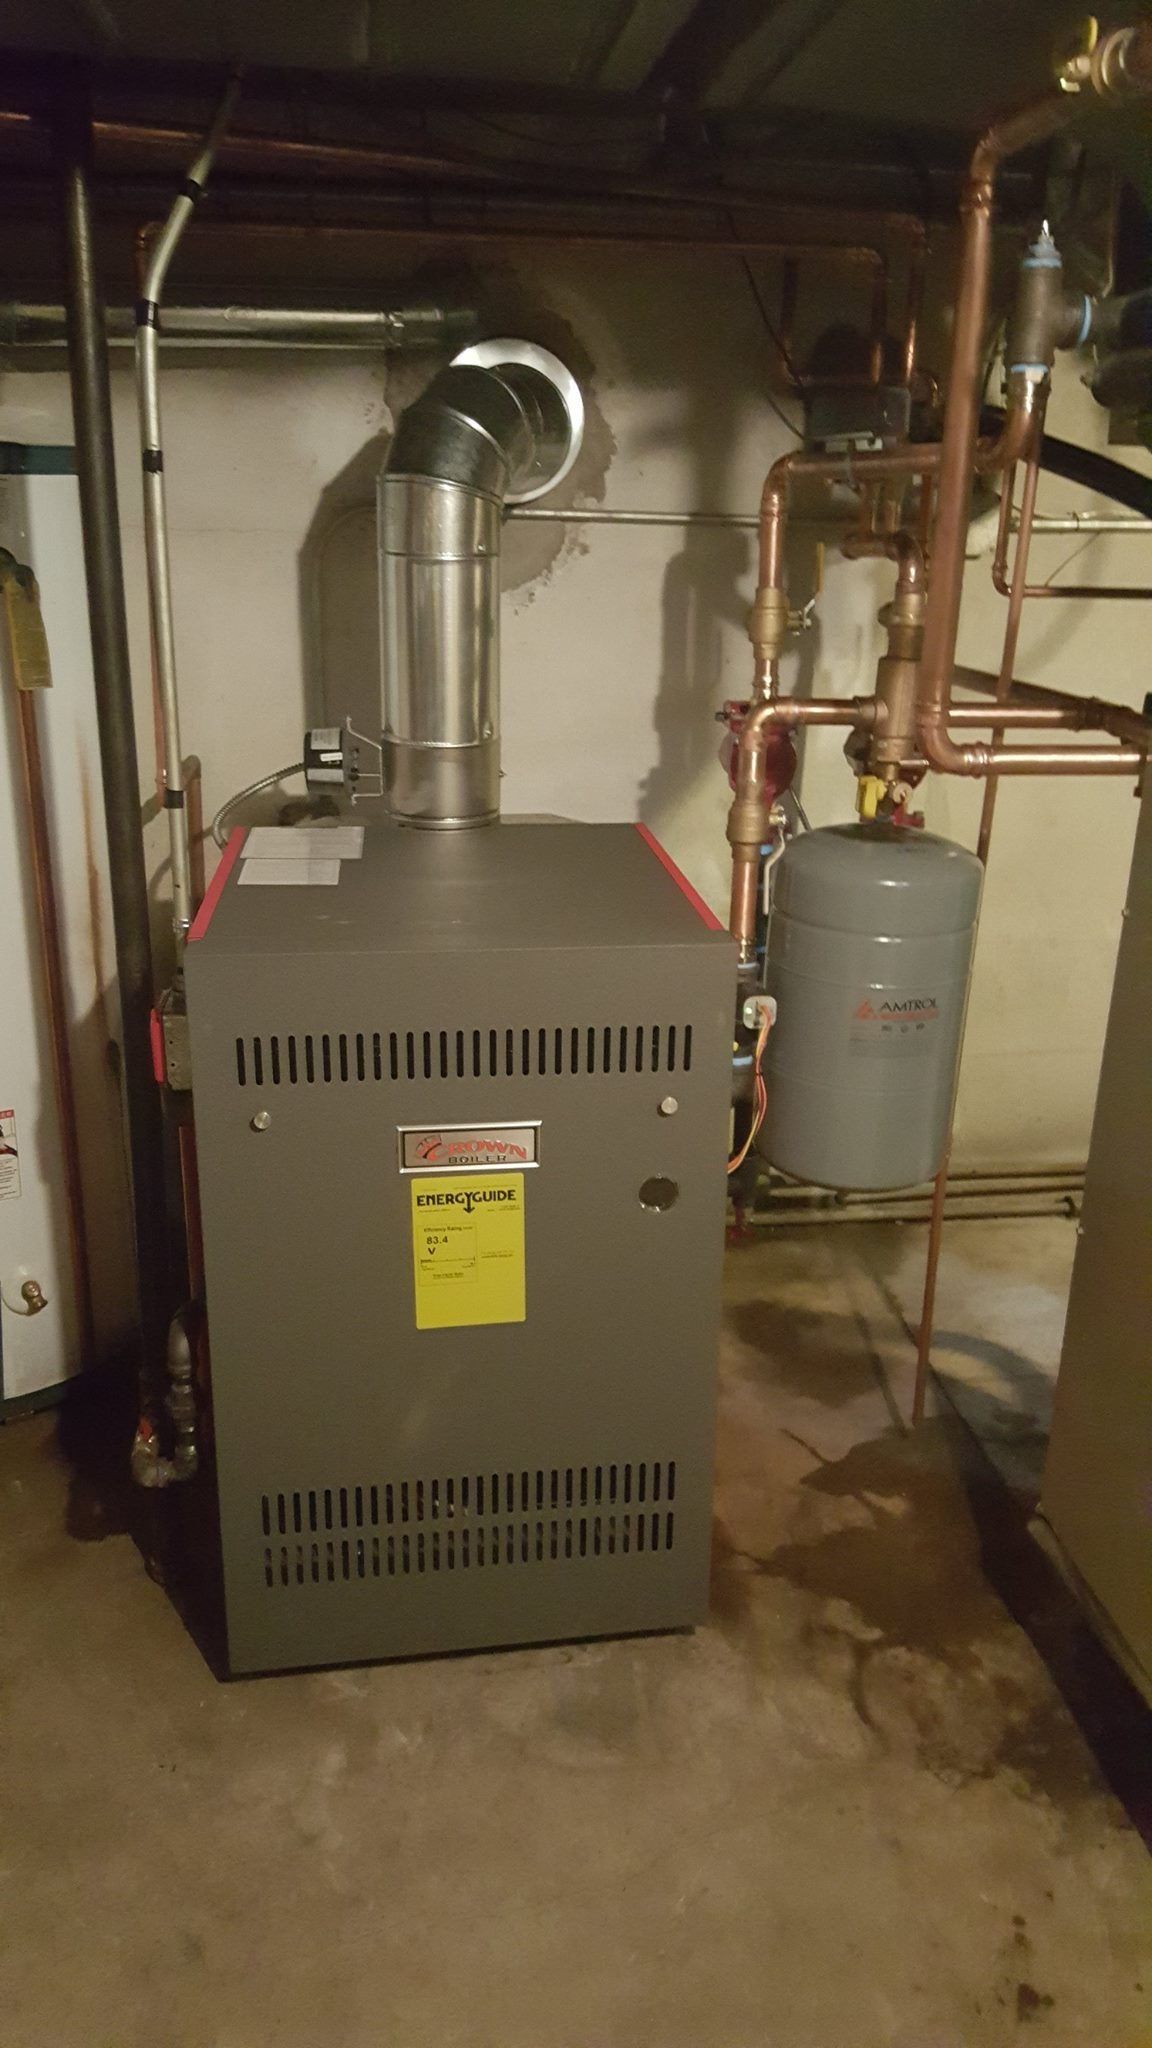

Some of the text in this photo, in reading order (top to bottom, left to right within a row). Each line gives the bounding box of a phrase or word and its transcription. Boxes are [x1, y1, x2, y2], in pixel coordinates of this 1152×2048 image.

[879, 998, 937, 1012] AMTROL
[448, 1154, 507, 1164] BOILER
[416, 1190, 516, 1207] ENERGYGUIDE
[426, 1235, 449, 1245] 83.4
